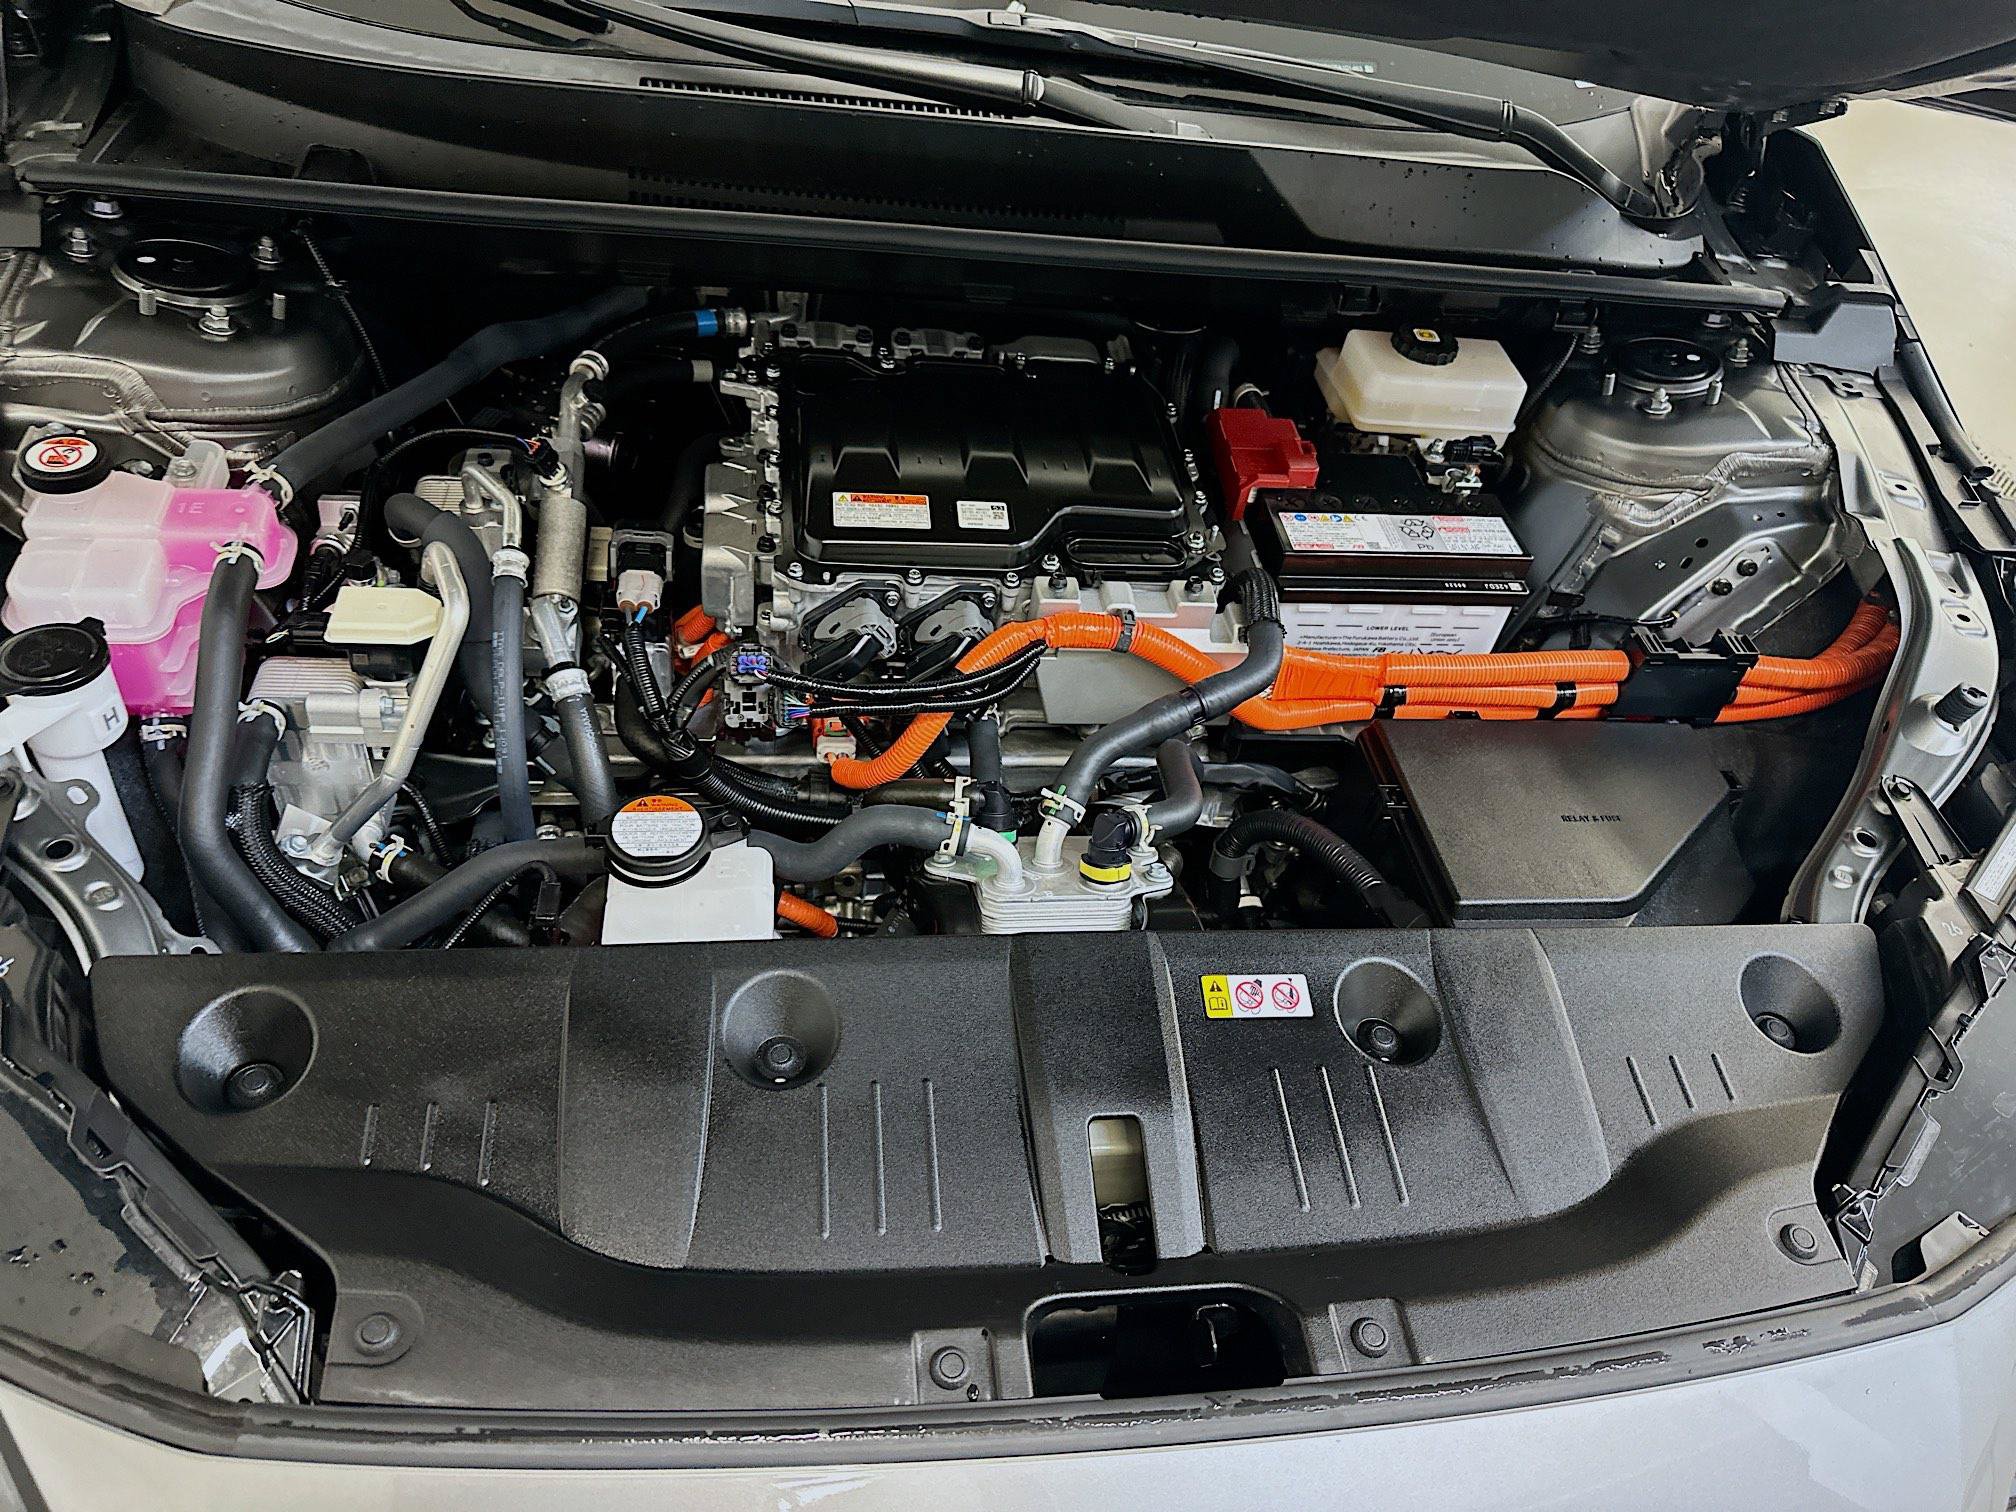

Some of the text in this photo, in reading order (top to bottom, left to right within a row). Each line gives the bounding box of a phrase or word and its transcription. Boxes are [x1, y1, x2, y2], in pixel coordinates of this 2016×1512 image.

[1417, 543, 1434, 551] Pb
[103, 706, 120, 731] H
[1560, 815, 1590, 823] RELAY
